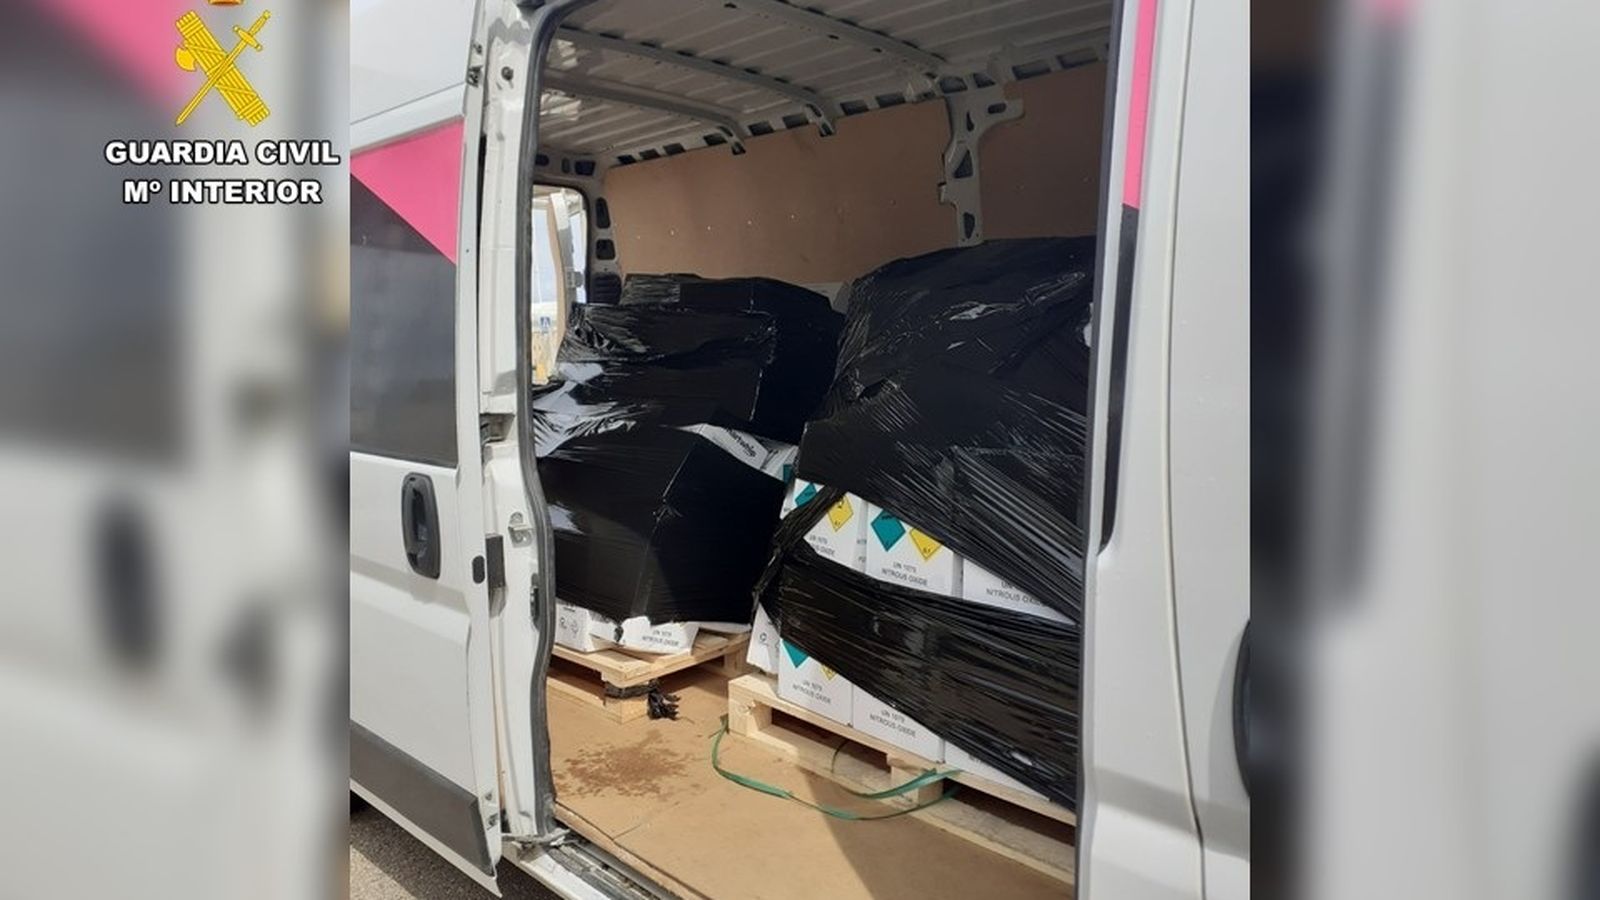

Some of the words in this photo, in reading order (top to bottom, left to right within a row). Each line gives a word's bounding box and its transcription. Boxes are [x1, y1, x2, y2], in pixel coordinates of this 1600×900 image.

[892, 561, 902, 569] UN
[881, 568, 908, 581] NITROUS
[908, 575, 928, 587] OXIDE
[985, 587, 1020, 602] NITROUS
[870, 713, 896, 729] NITROUS
[897, 724, 917, 738] OXIDE
